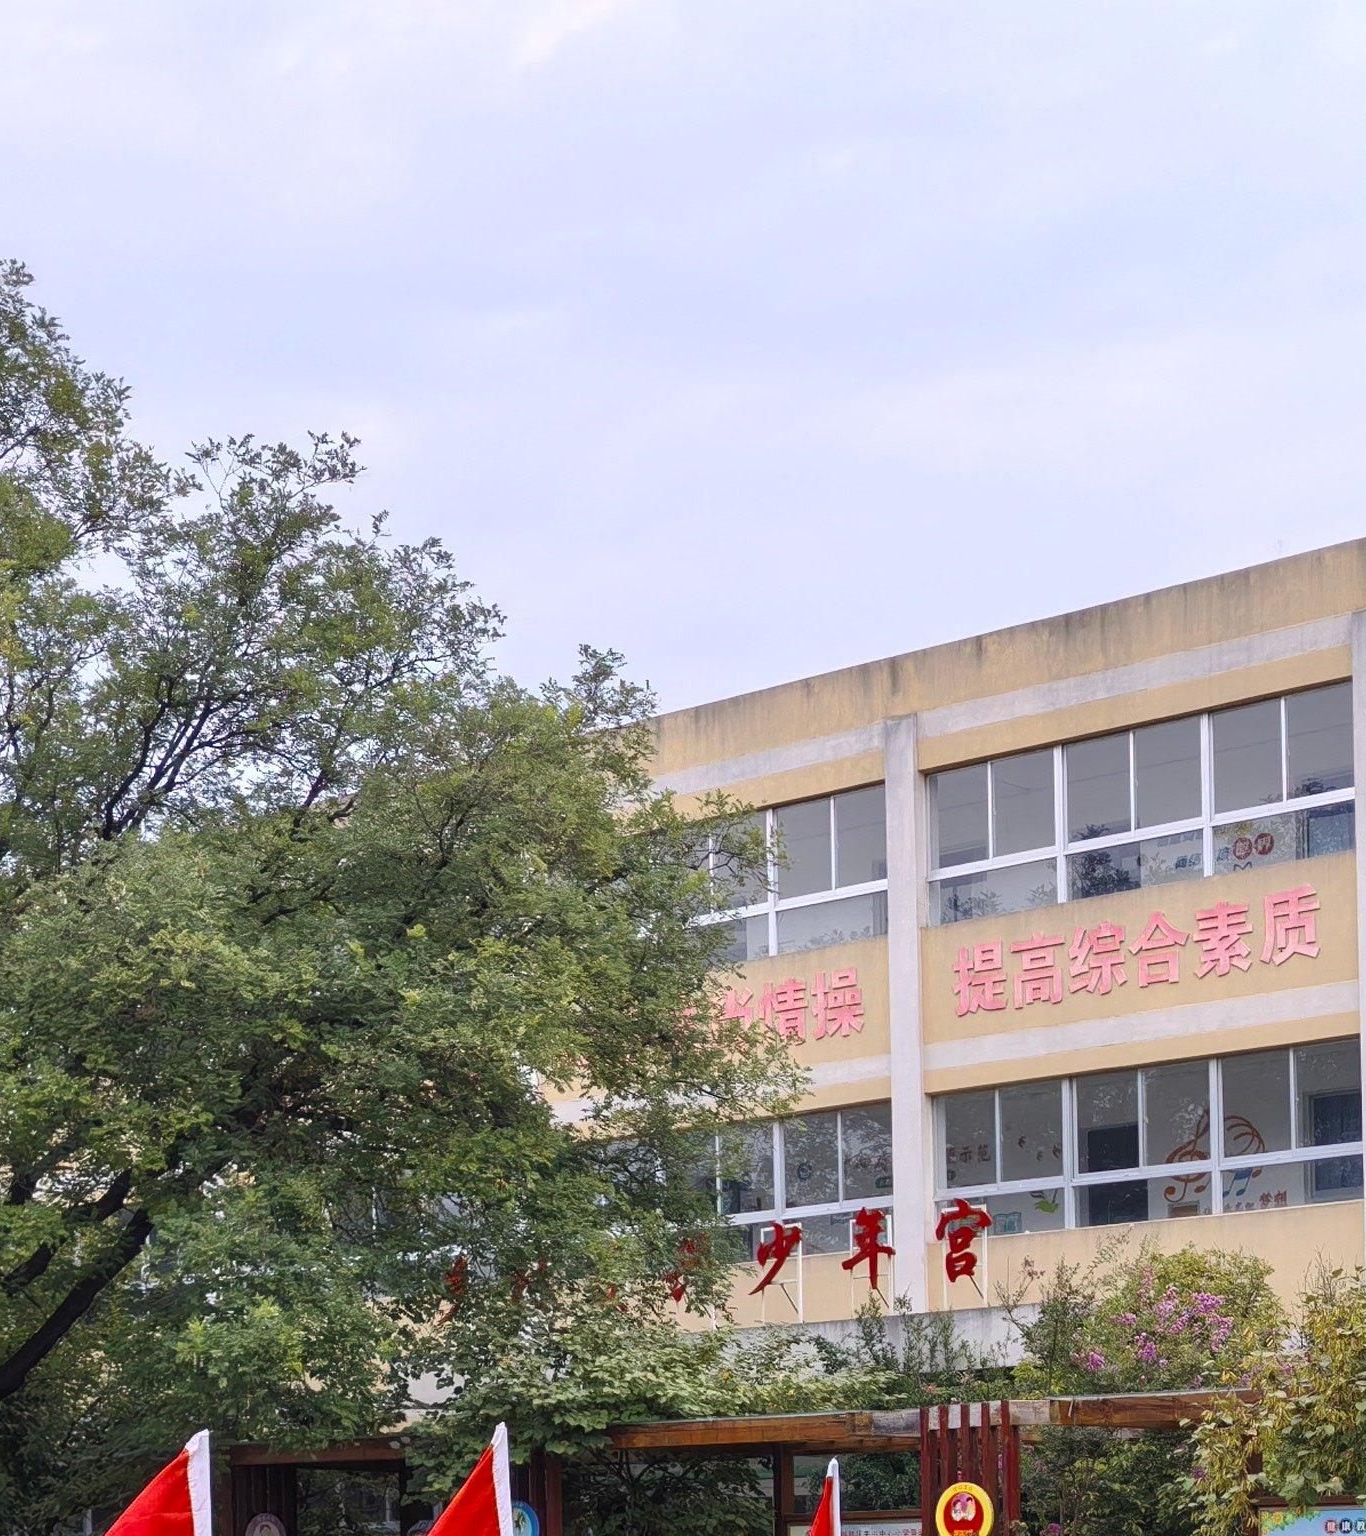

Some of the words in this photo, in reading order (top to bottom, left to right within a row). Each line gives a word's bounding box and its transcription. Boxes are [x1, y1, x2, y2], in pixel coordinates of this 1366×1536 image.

[952, 883, 1321, 1017] 提高综合素质
[749, 1198, 993, 1295] 少年宫
